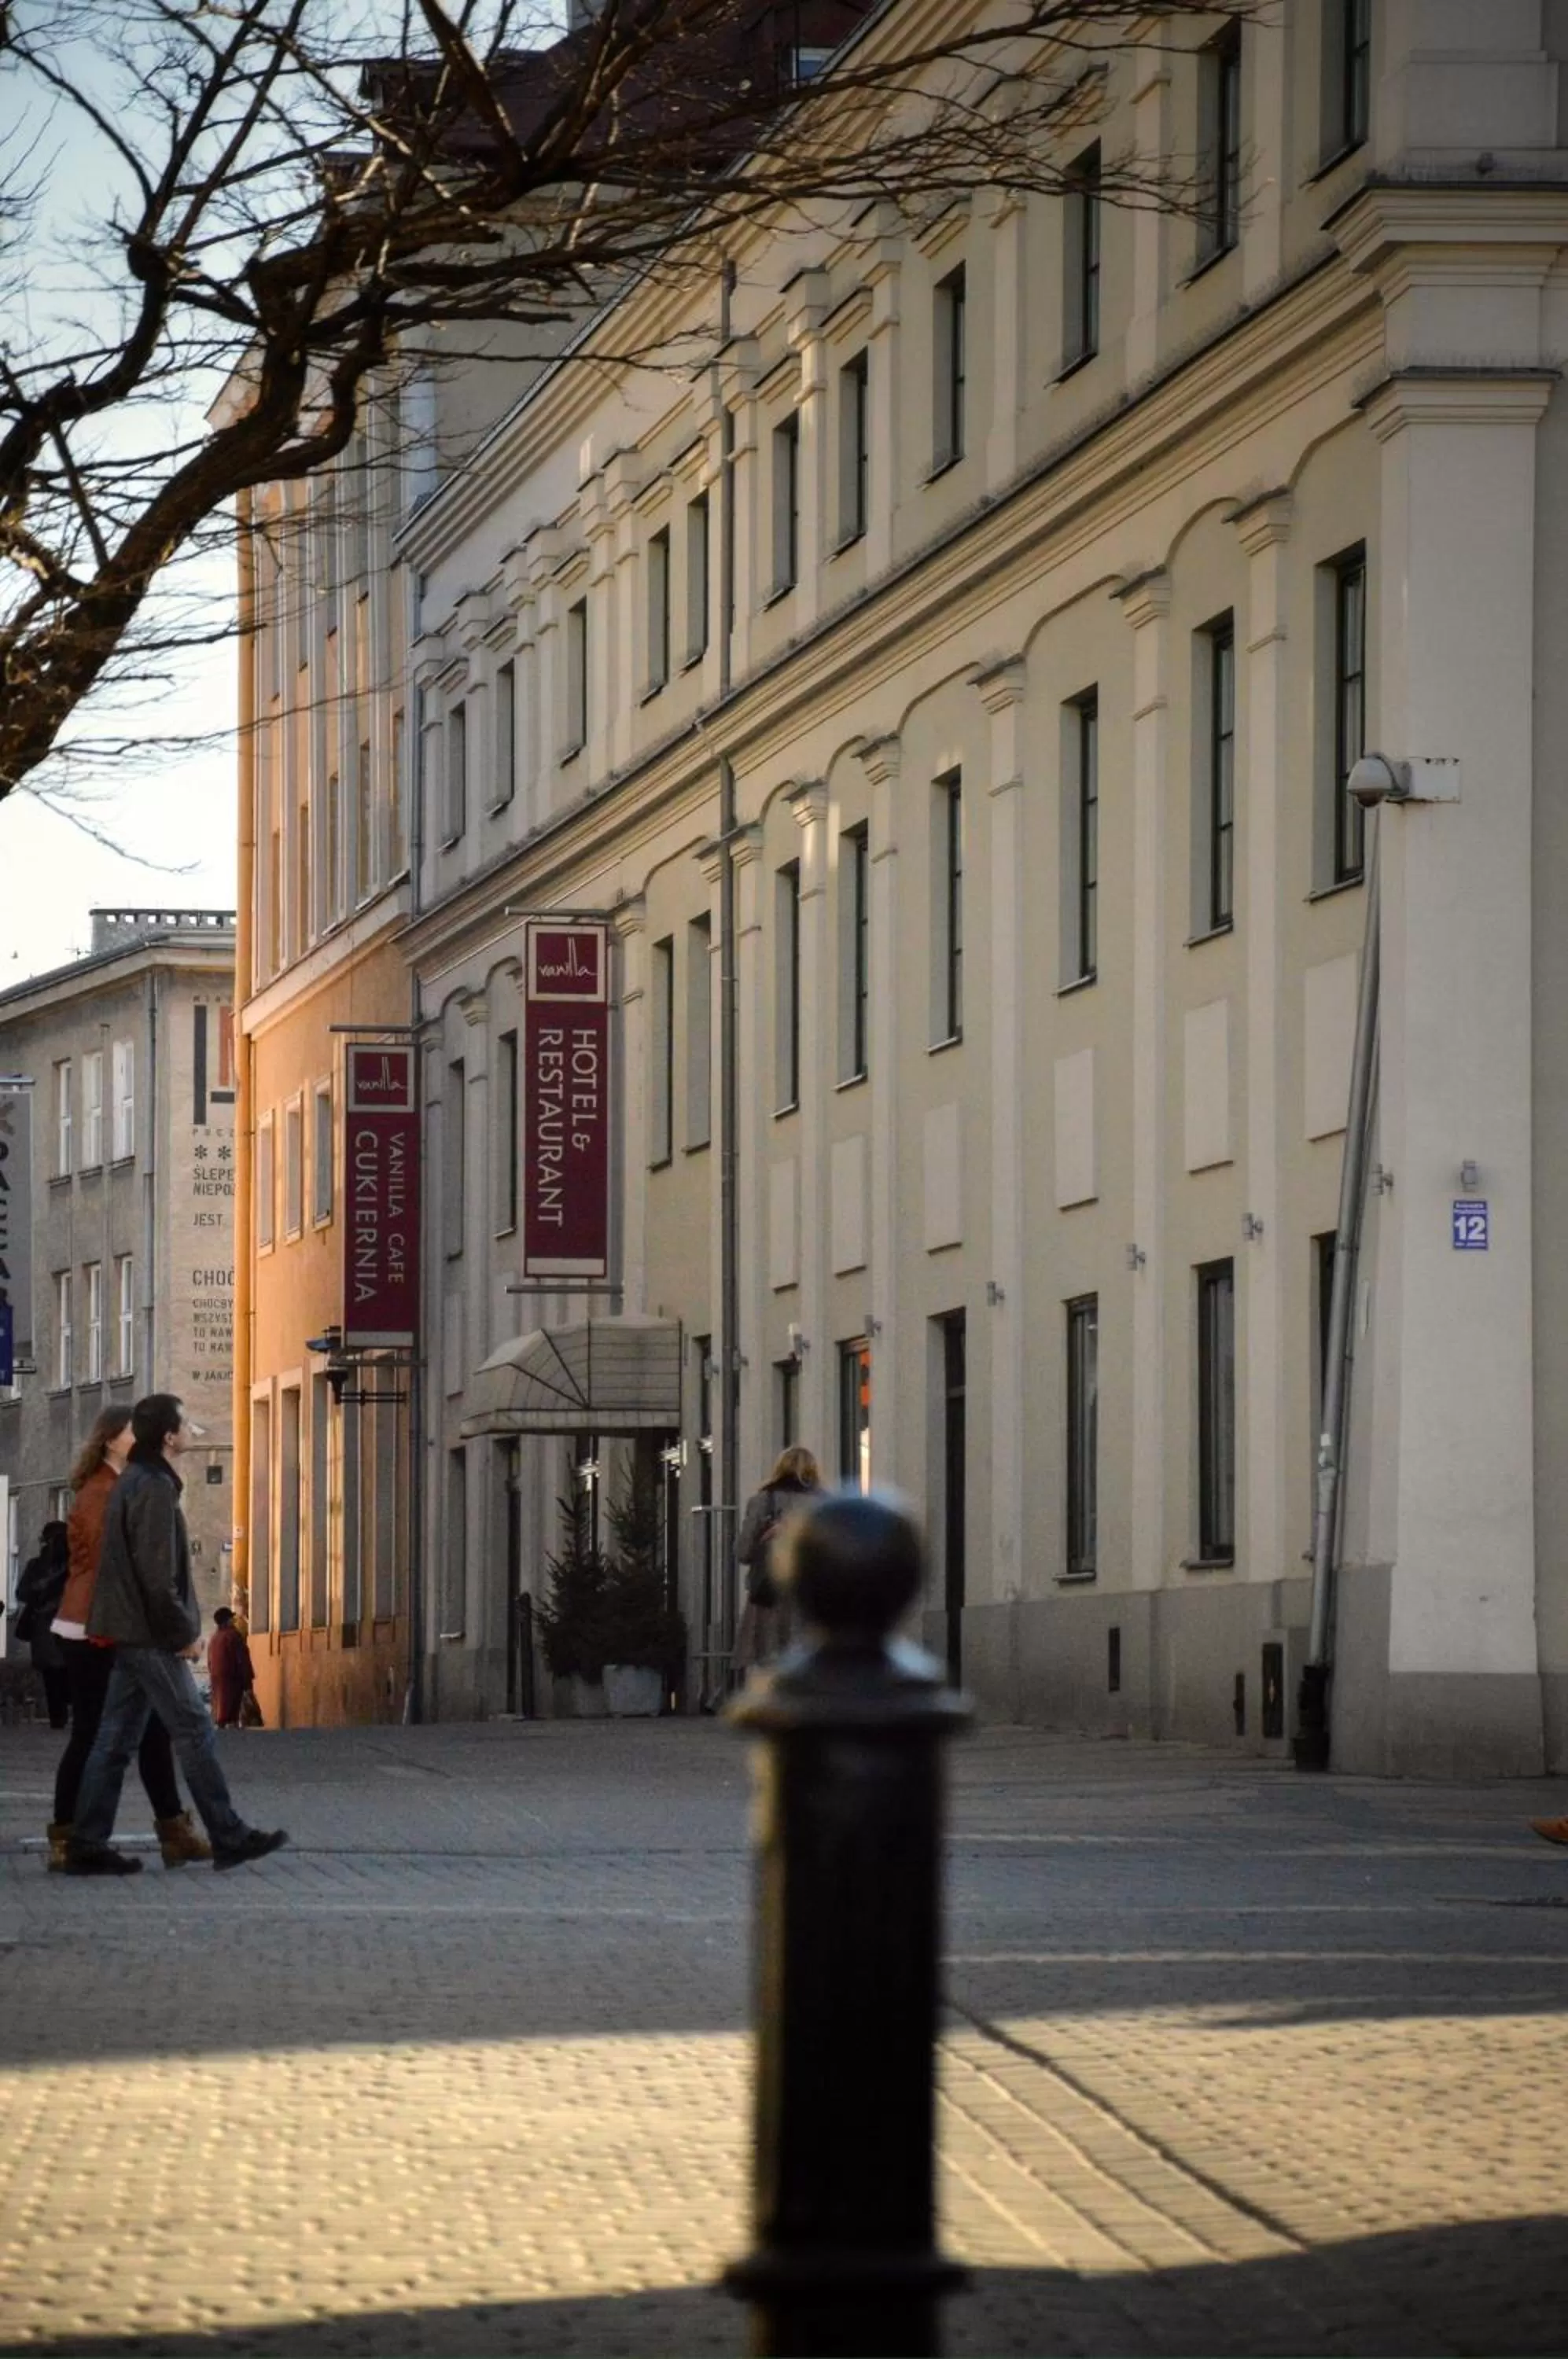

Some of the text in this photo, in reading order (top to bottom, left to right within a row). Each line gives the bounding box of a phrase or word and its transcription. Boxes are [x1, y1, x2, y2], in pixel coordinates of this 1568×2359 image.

[538, 937, 596, 977] vanilla
[356, 1056, 406, 1091] vanilla
[572, 1028, 597, 1152] HOTEL &
[538, 1028, 564, 1226] RESTAURANT
[193, 1213, 223, 1226] JEST
[354, 1131, 378, 1303] CUKIERNIA
[388, 1132, 405, 1283] VANILLA CAFE
[1455, 1216, 1485, 1240] 12
